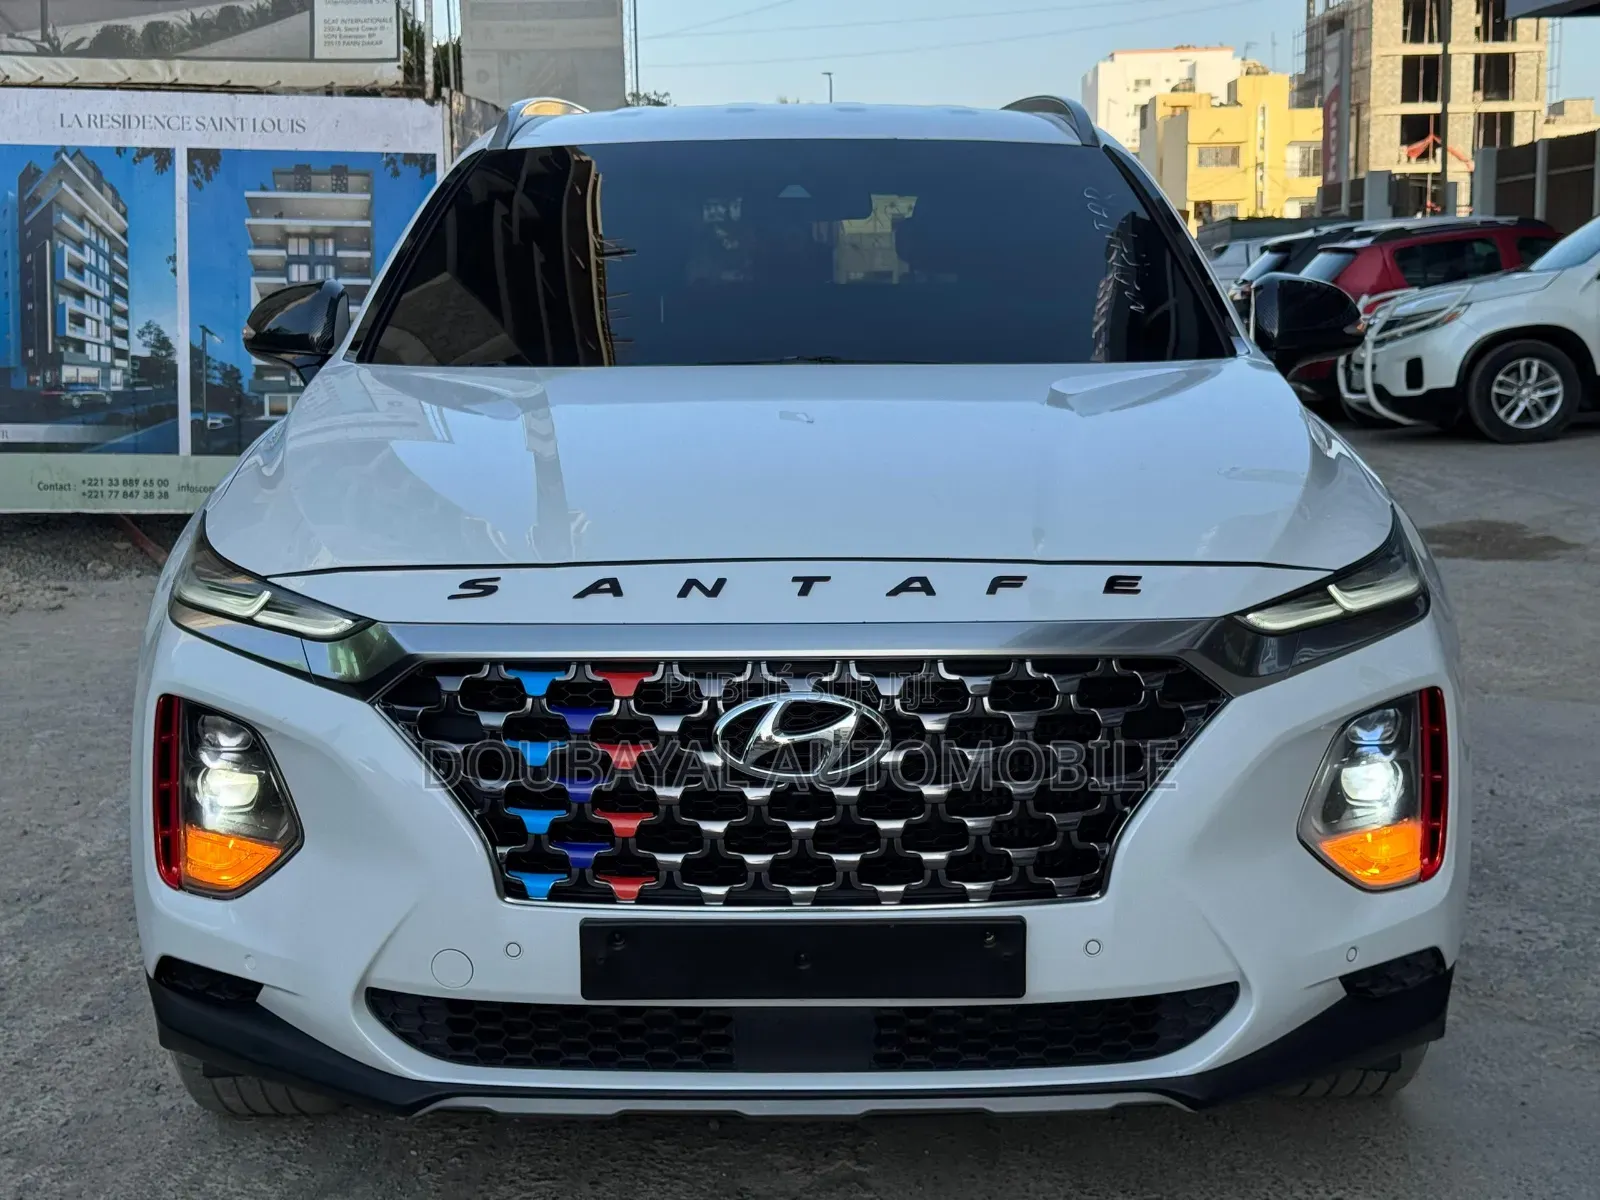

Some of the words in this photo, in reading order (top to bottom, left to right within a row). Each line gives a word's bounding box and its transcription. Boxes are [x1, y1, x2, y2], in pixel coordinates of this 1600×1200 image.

[60, 113, 83, 129] LA
[87, 113, 192, 132] RESIDENCE
[195, 115, 248, 133] SAINT
[252, 117, 307, 135] LOUIS
[37, 481, 72, 492] Contact
[82, 478, 104, 487] +221
[107, 478, 120, 487] 33
[122, 478, 140, 487] 889
[143, 478, 155, 488] 65
[157, 478, 170, 488] 00
[82, 490, 104, 499] +221
[108, 490, 120, 499] 77
[122, 490, 140, 499] 847
[143, 490, 155, 500] 38
